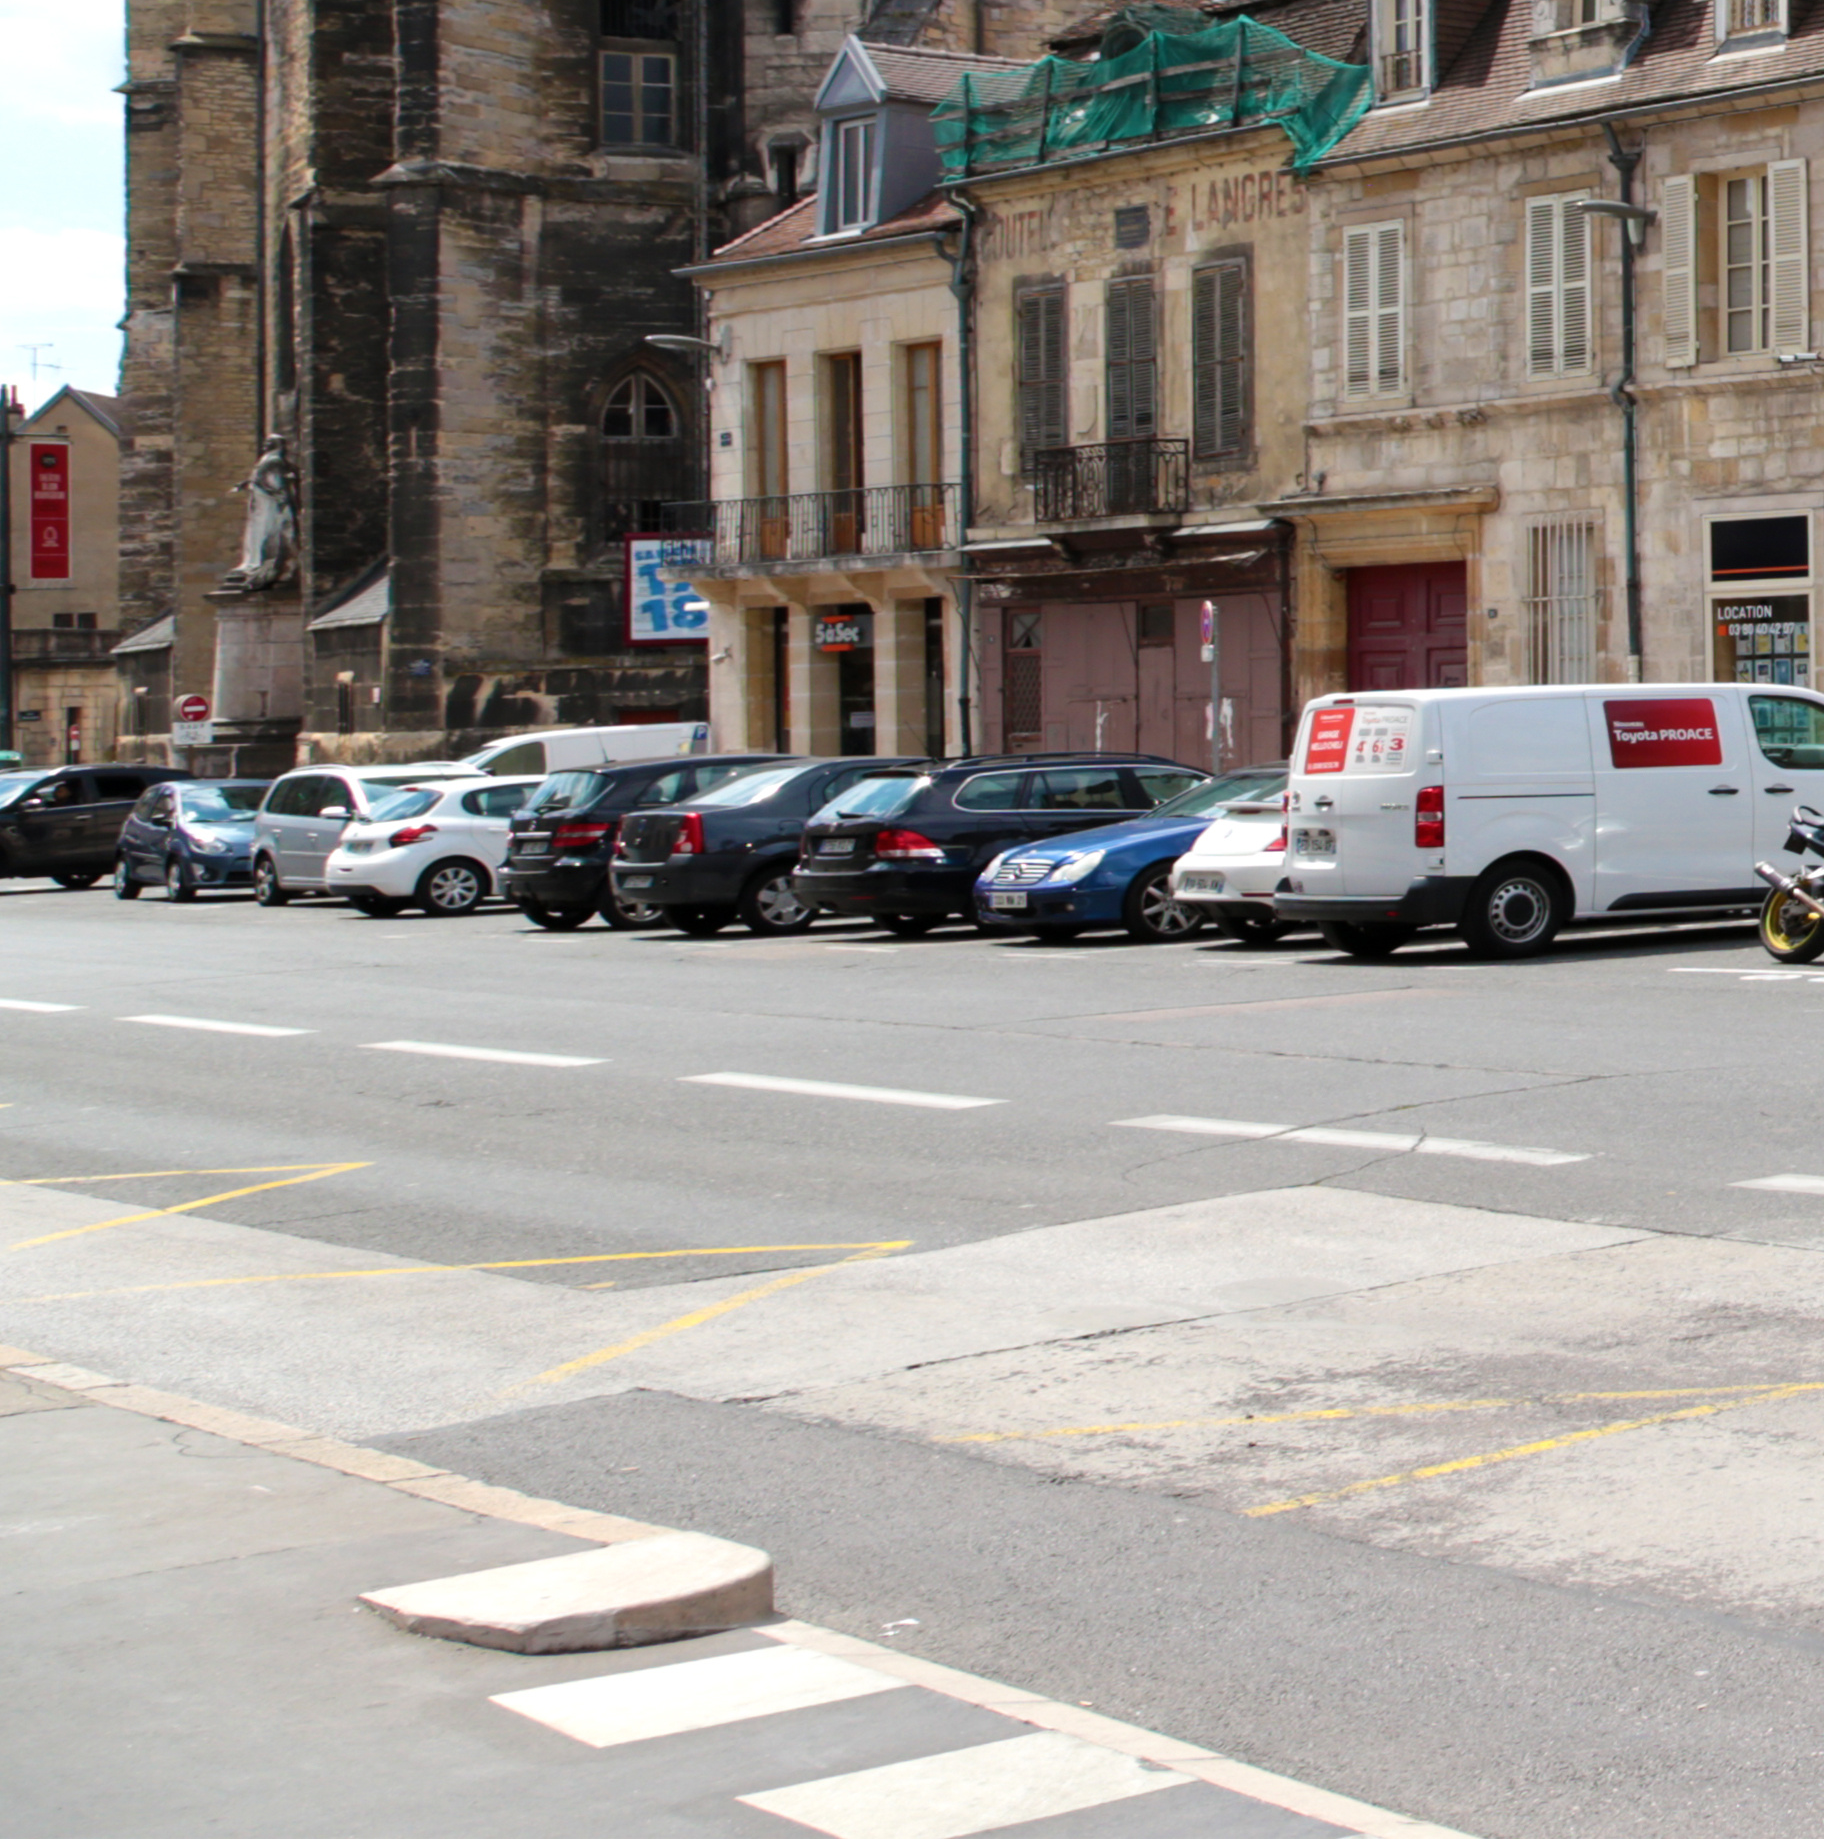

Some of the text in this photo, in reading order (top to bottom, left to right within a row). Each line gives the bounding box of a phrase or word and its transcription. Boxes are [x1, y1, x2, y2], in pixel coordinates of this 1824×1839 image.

[1191, 171, 1307, 232] LANGRES
[640, 594, 708, 632] 18
[1717, 605, 1772, 620] LOCATION
[1728, 624, 1740, 636] 03
[1613, 728, 1715, 744] Toyota PROACE
[1389, 737, 1404, 752] 3
